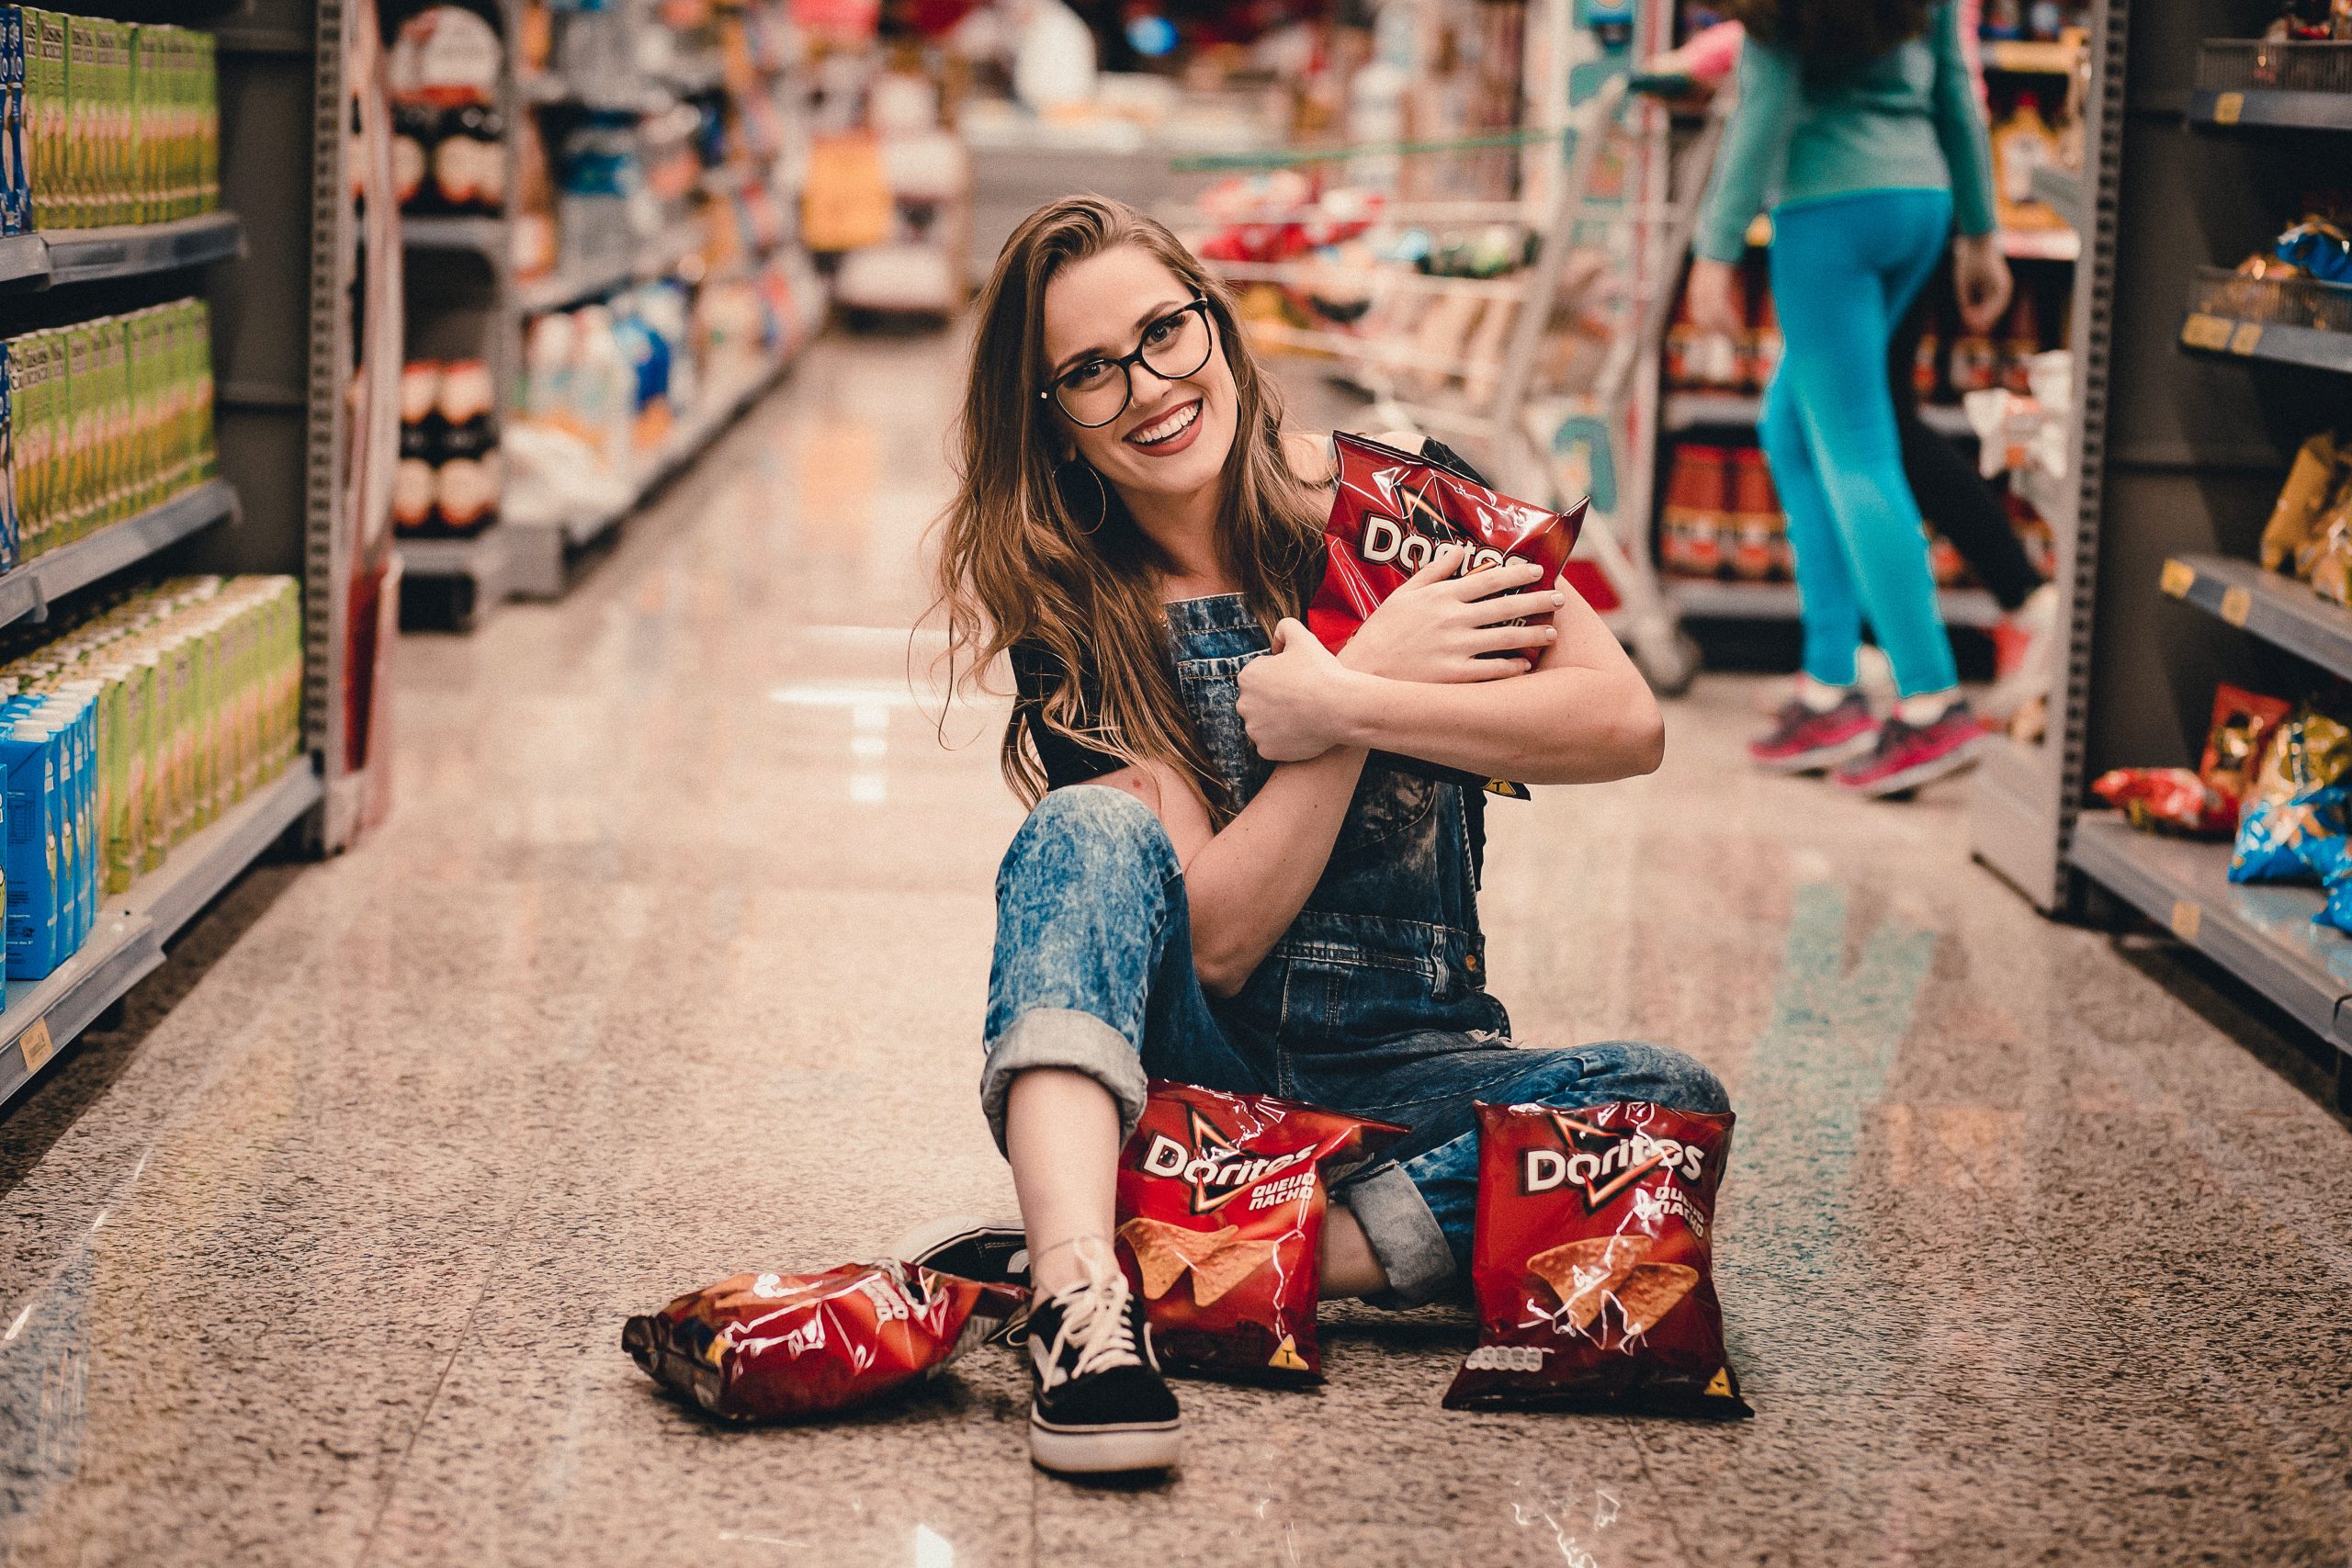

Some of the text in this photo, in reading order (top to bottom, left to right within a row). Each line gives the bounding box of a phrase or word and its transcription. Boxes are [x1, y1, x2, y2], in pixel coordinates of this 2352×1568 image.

[1492, 781, 1504, 792] T
[1143, 1134, 1319, 1185] Doritos
[1527, 1135, 1704, 1191] Doritos
[1251, 1172, 1317, 1198] QUEIJO
[1249, 1187, 1314, 1211] NACHO
[1283, 1348, 1293, 1365] T
